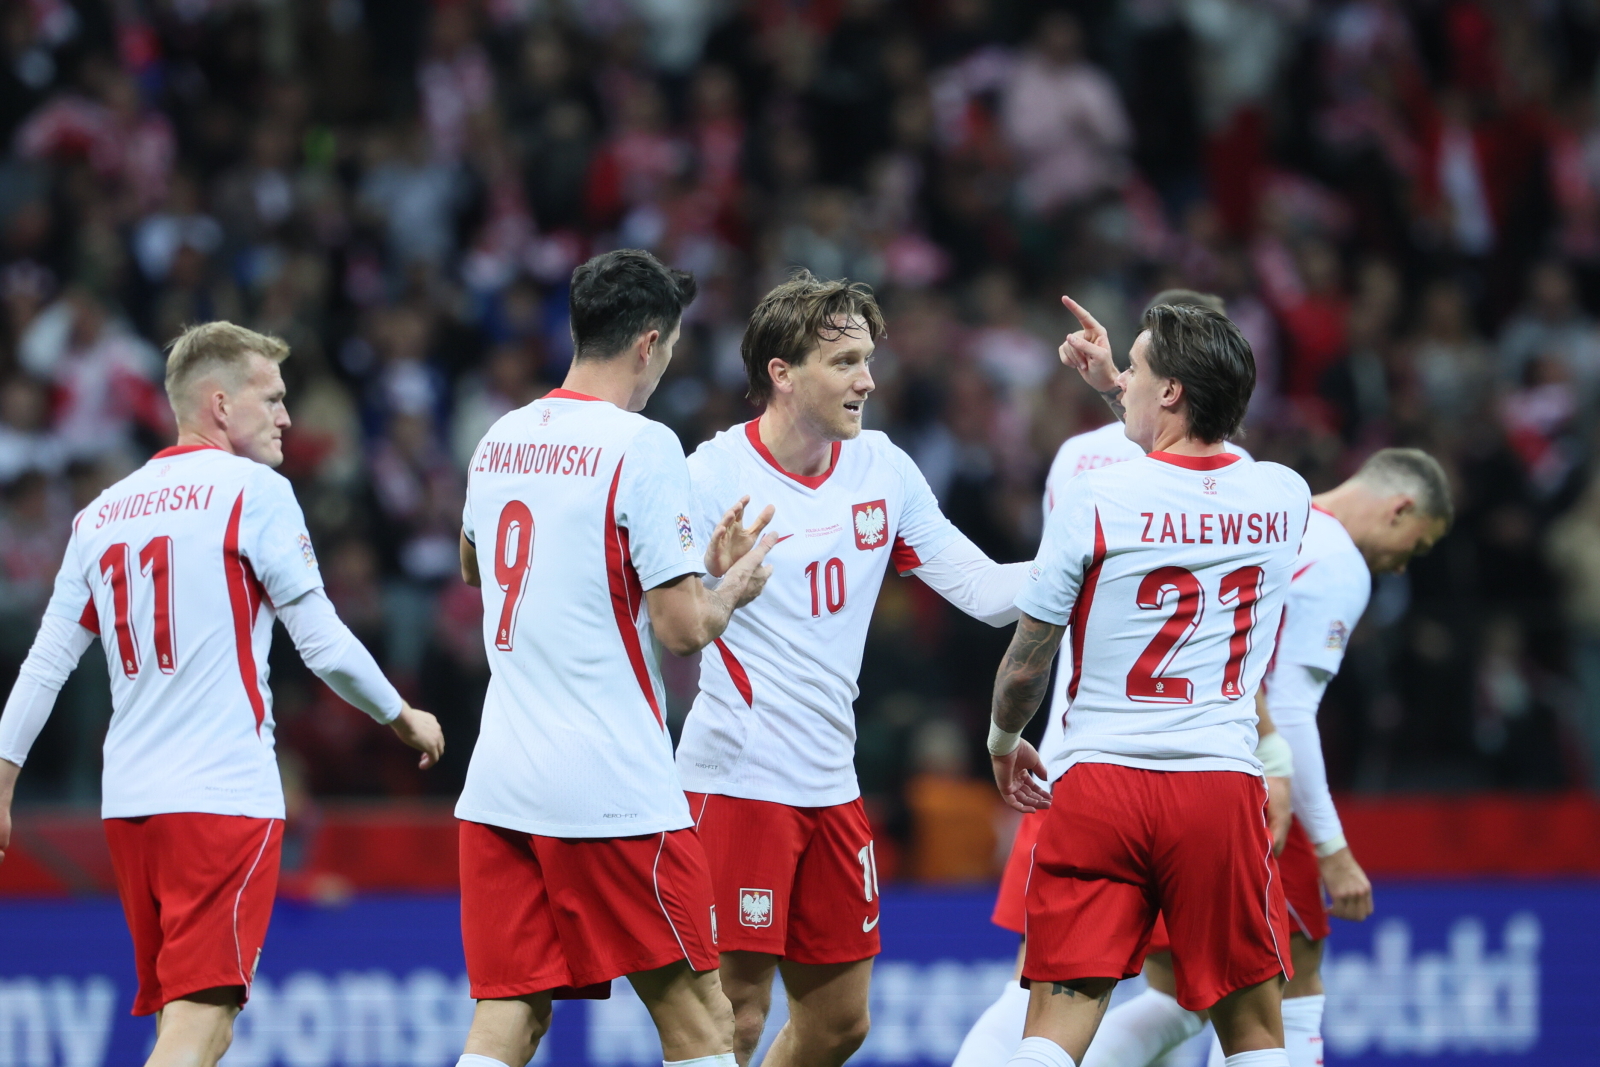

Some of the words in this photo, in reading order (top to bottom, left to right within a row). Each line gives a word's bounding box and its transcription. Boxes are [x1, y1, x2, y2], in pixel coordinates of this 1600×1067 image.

[494, 499, 536, 652] 9
[804, 556, 848, 619] 10
[1139, 510, 1288, 545] ZALEWSKI
[99, 534, 178, 681] 11
[1125, 565, 1266, 704] 21
